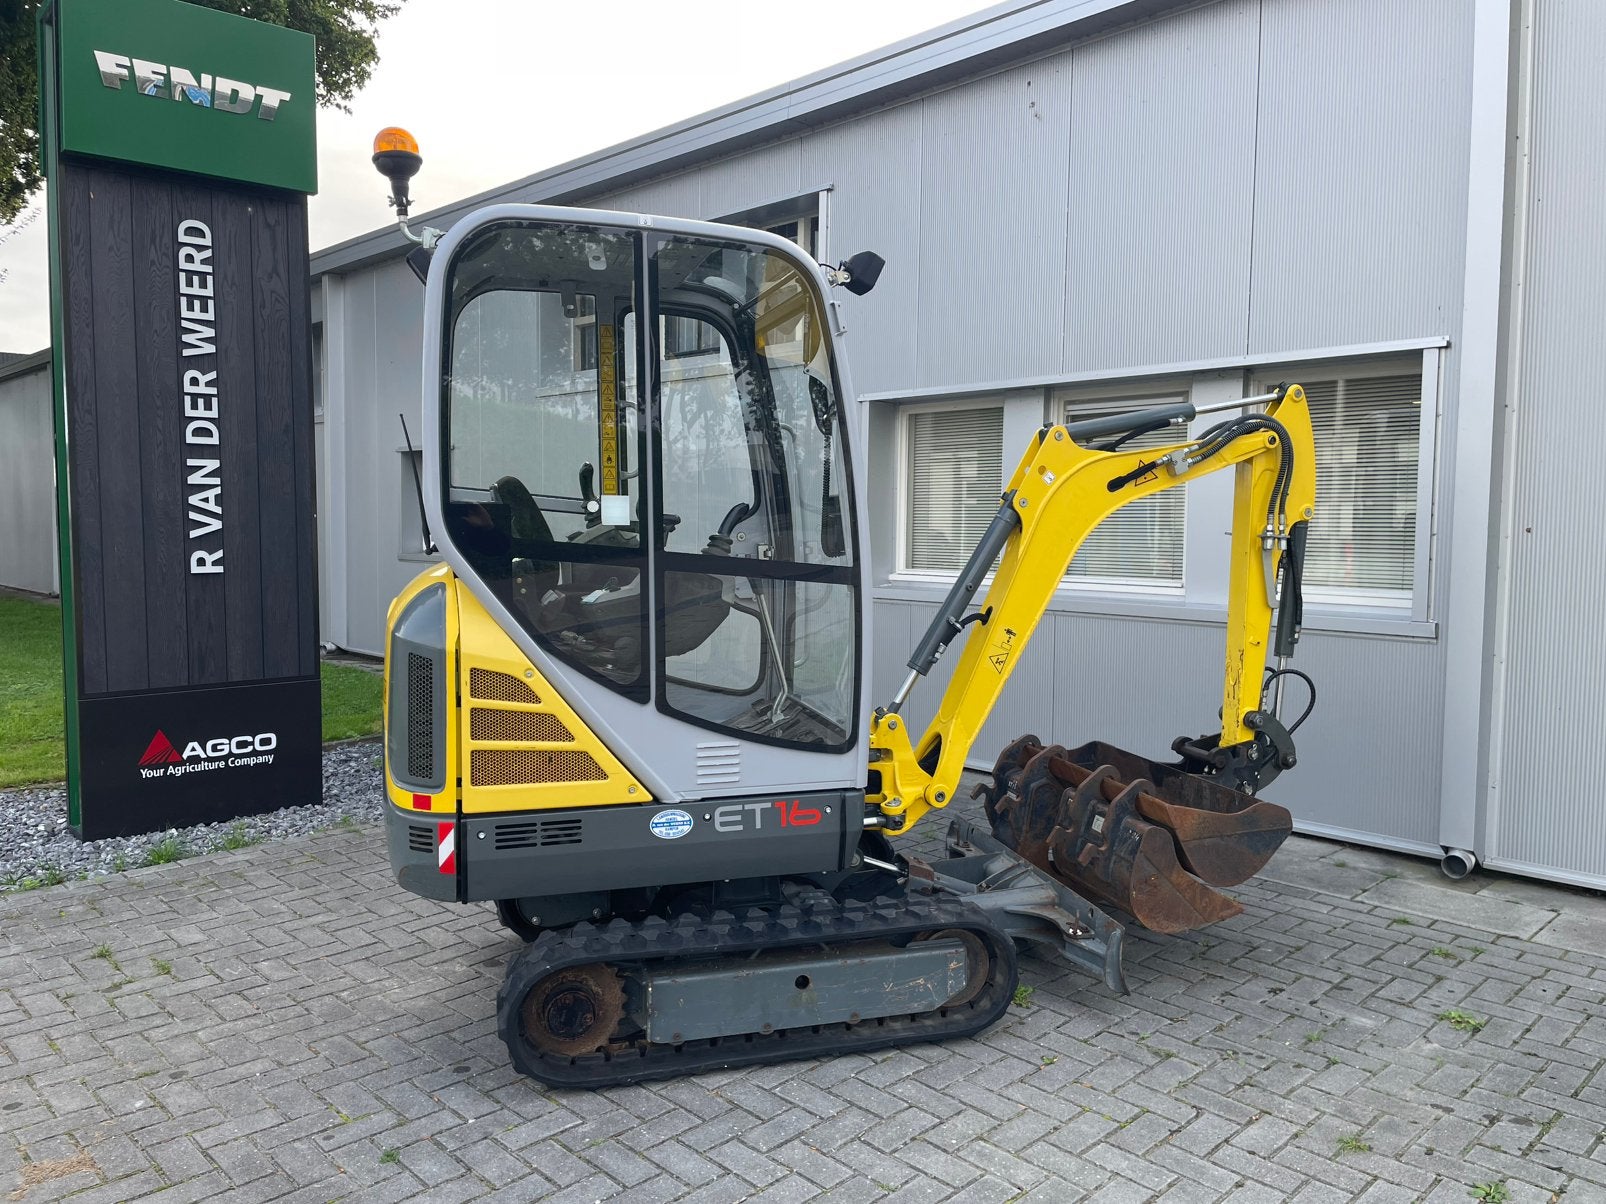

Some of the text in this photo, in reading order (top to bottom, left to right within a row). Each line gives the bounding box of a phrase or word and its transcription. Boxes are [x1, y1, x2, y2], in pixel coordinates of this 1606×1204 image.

[93, 50, 291, 121] FENDT
[177, 219, 224, 574] R VAN DER WEERD
[182, 732, 277, 760] AGCO
[140, 754, 275, 779] Your Agriculture Company
[714, 800, 822, 832] ET16
